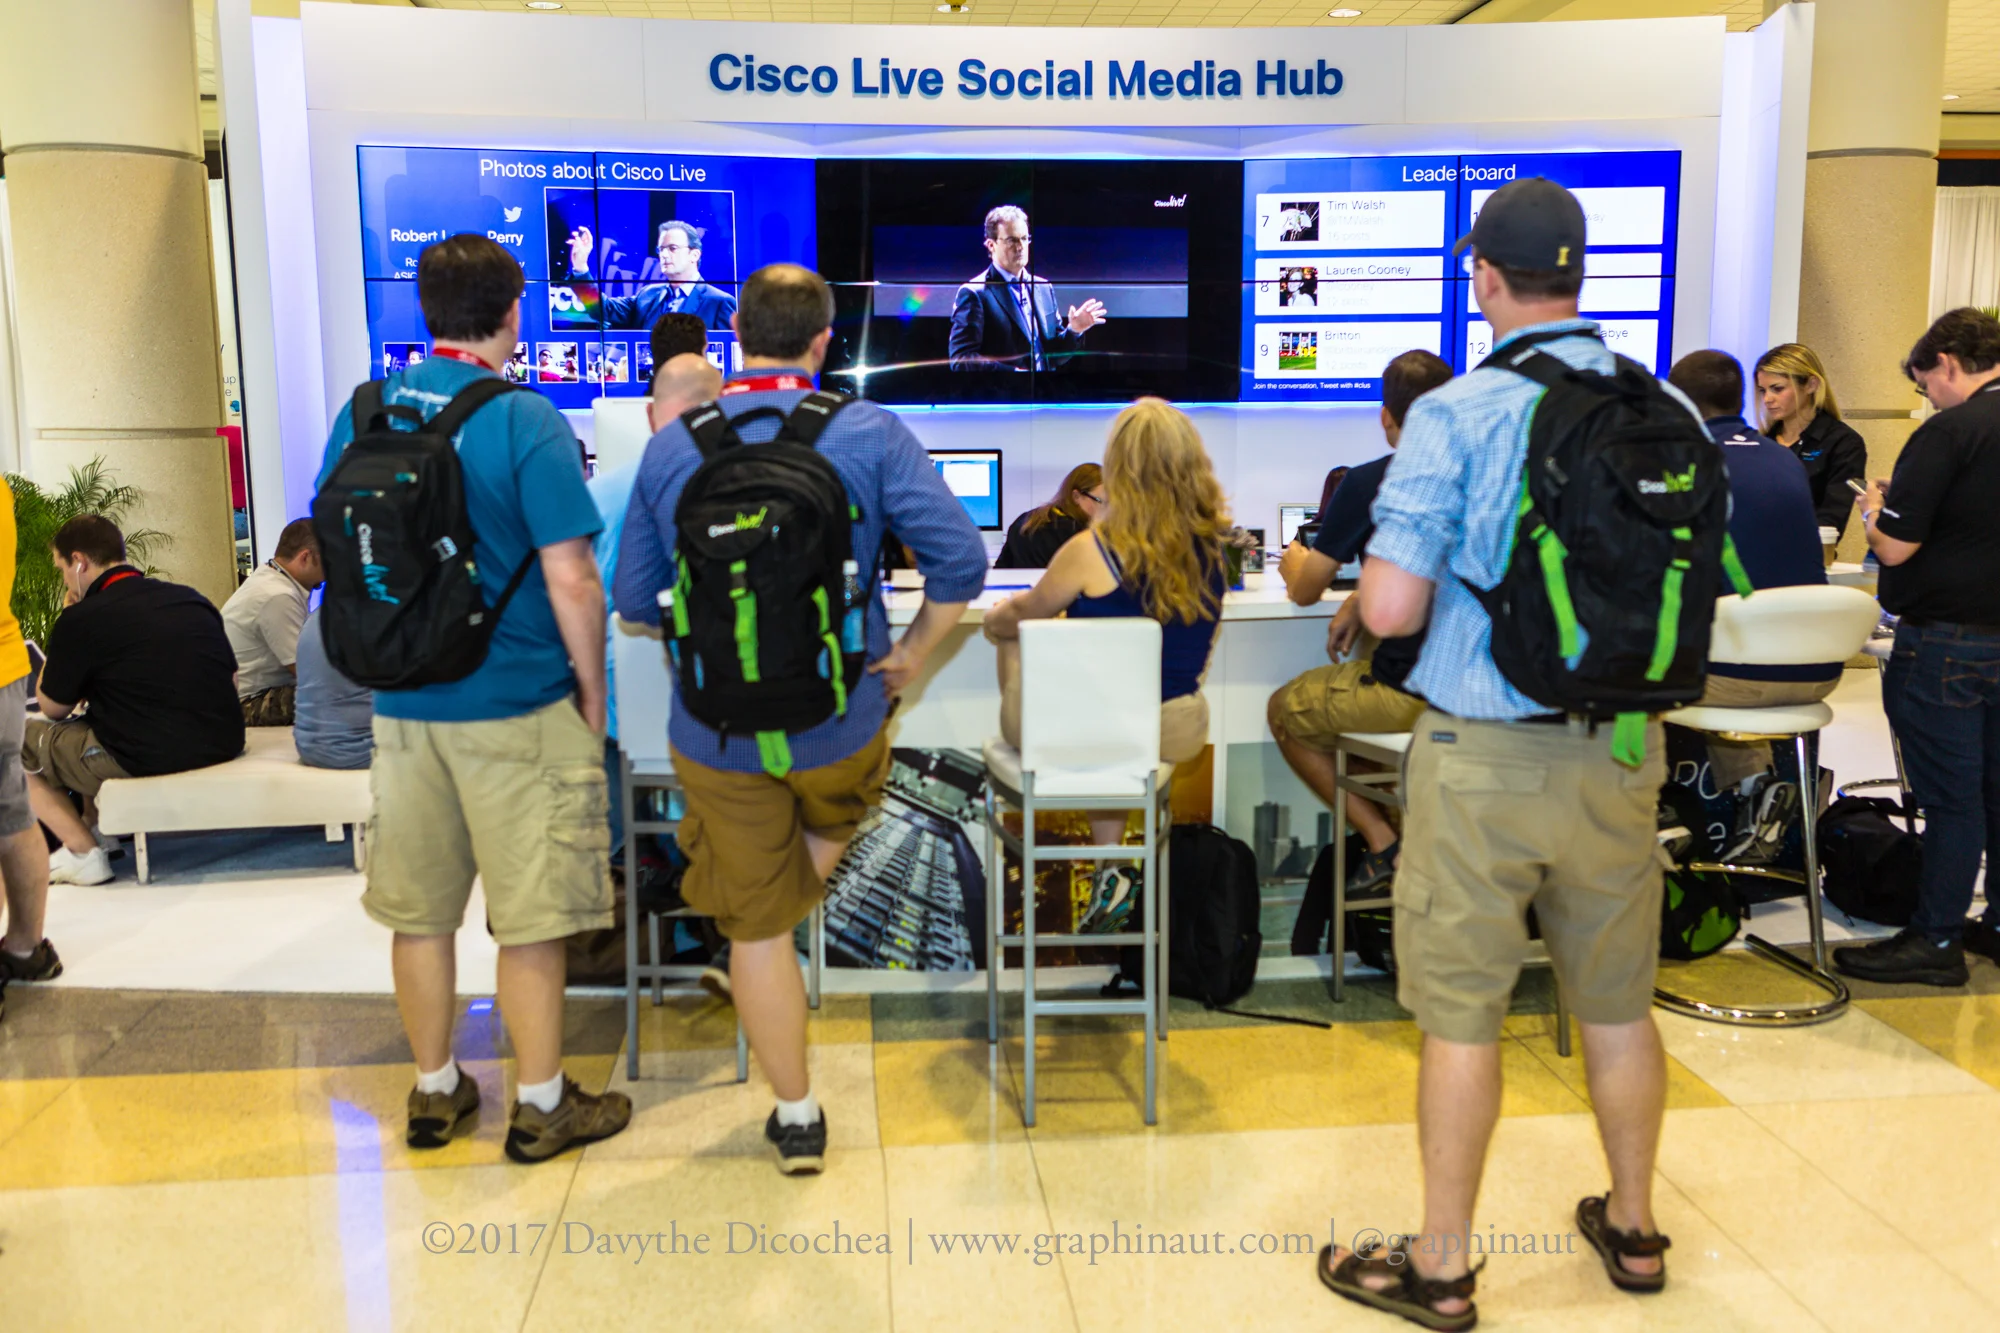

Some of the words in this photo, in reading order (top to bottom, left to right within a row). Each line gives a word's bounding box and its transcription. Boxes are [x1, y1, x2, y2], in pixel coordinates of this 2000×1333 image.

[709, 53, 838, 95] Cisco
[853, 57, 944, 96] Live
[958, 59, 1093, 98] Social
[1108, 60, 1242, 97] Media
[1257, 59, 1344, 97] Hub
[480, 159, 547, 178] Photos
[552, 161, 606, 180] about
[611, 162, 664, 181] Cisco
[670, 164, 707, 182] Live
[1327, 199, 1348, 210] Tim
[1351, 199, 1387, 210] Walsh
[1261, 215, 1270, 228] 7
[390, 228, 439, 243] Robert
[487, 229, 524, 247] Perry
[1325, 264, 1365, 276] Lauren
[1367, 264, 1412, 278] Cooney
[1324, 330, 1361, 341] Britton
[1260, 344, 1269, 357] 9
[1468, 341, 1487, 355] 12
[1267, 382, 1278, 390] the
